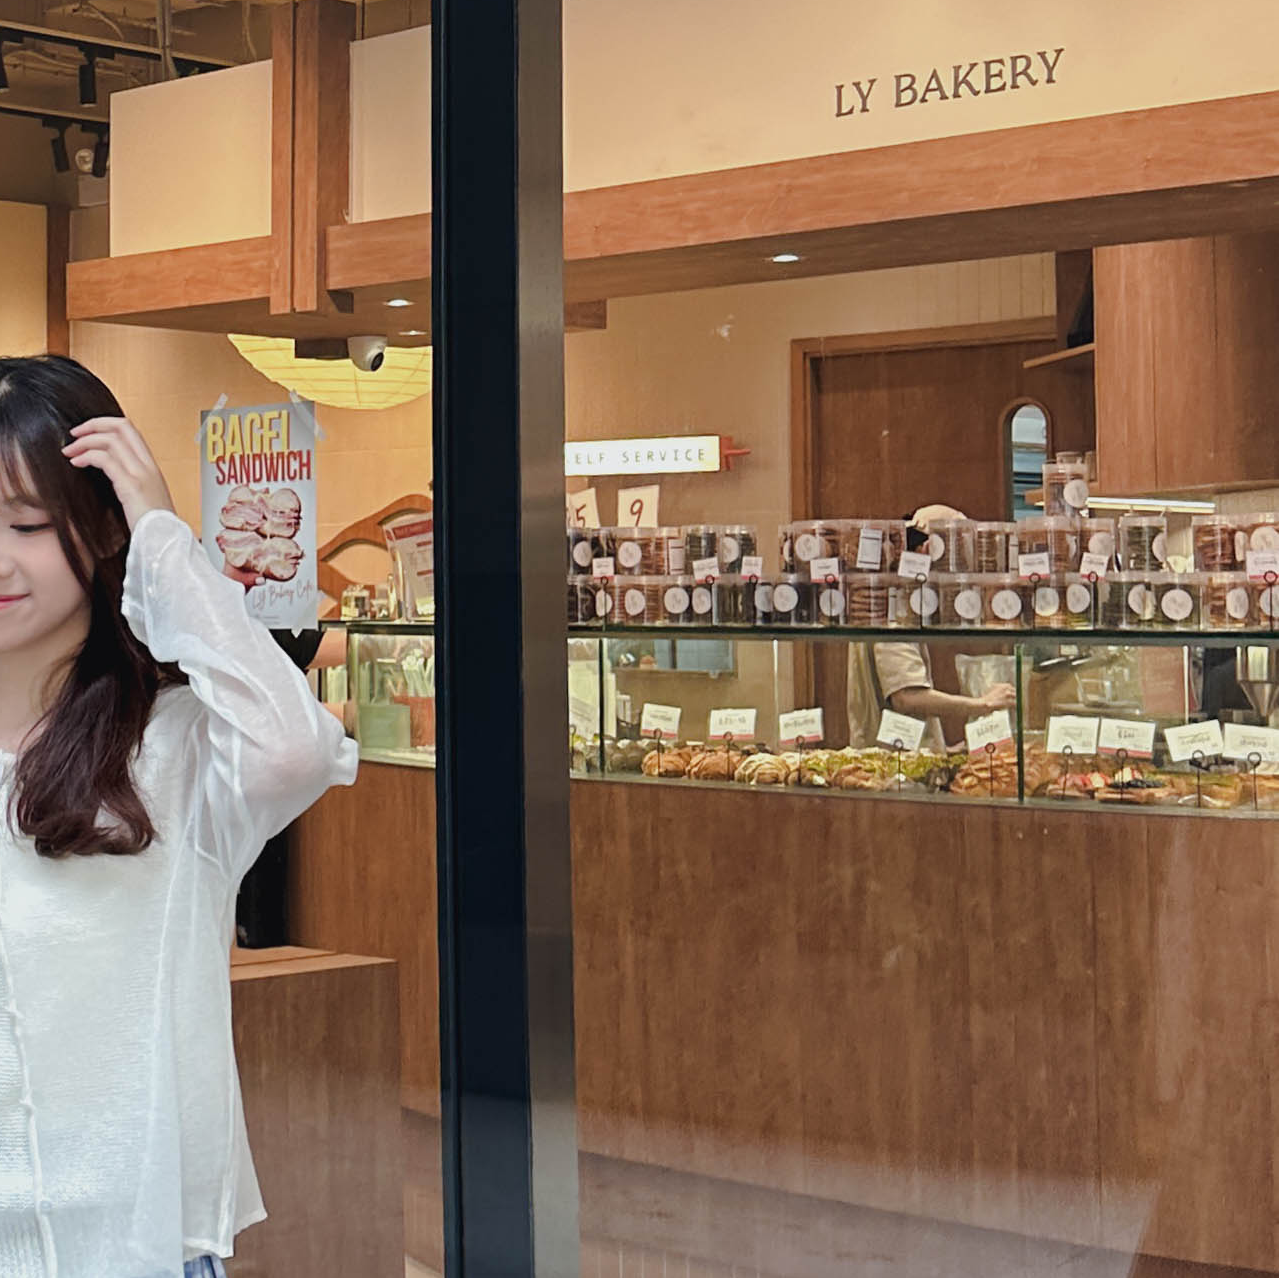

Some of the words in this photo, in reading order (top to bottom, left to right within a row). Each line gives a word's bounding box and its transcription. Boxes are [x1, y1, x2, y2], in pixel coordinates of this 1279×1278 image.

[834, 78, 878, 117] LY
[893, 47, 1065, 109] BAKERY
[215, 450, 312, 486] SANDWICH
[566, 452, 606, 467] ELF
[621, 448, 706, 464] SERVICE
